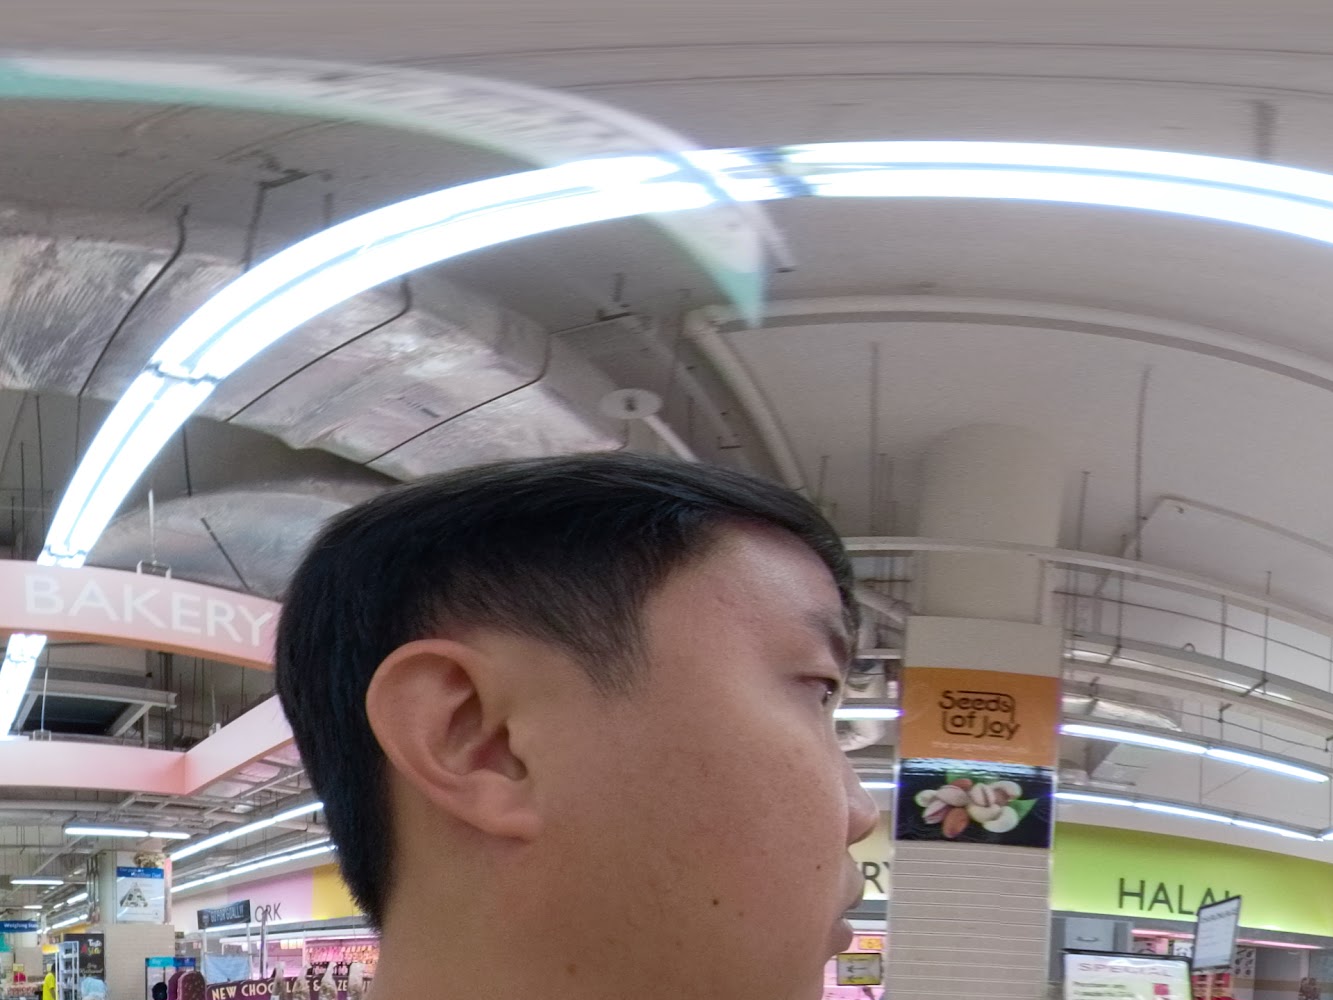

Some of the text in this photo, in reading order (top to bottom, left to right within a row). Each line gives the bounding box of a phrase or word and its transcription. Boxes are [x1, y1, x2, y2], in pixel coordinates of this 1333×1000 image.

[25, 575, 273, 646] BAKERY
[938, 690, 1012, 713] Seeds
[951, 711, 1020, 740] of Joy
[211, 984, 237, 1000] NEW
